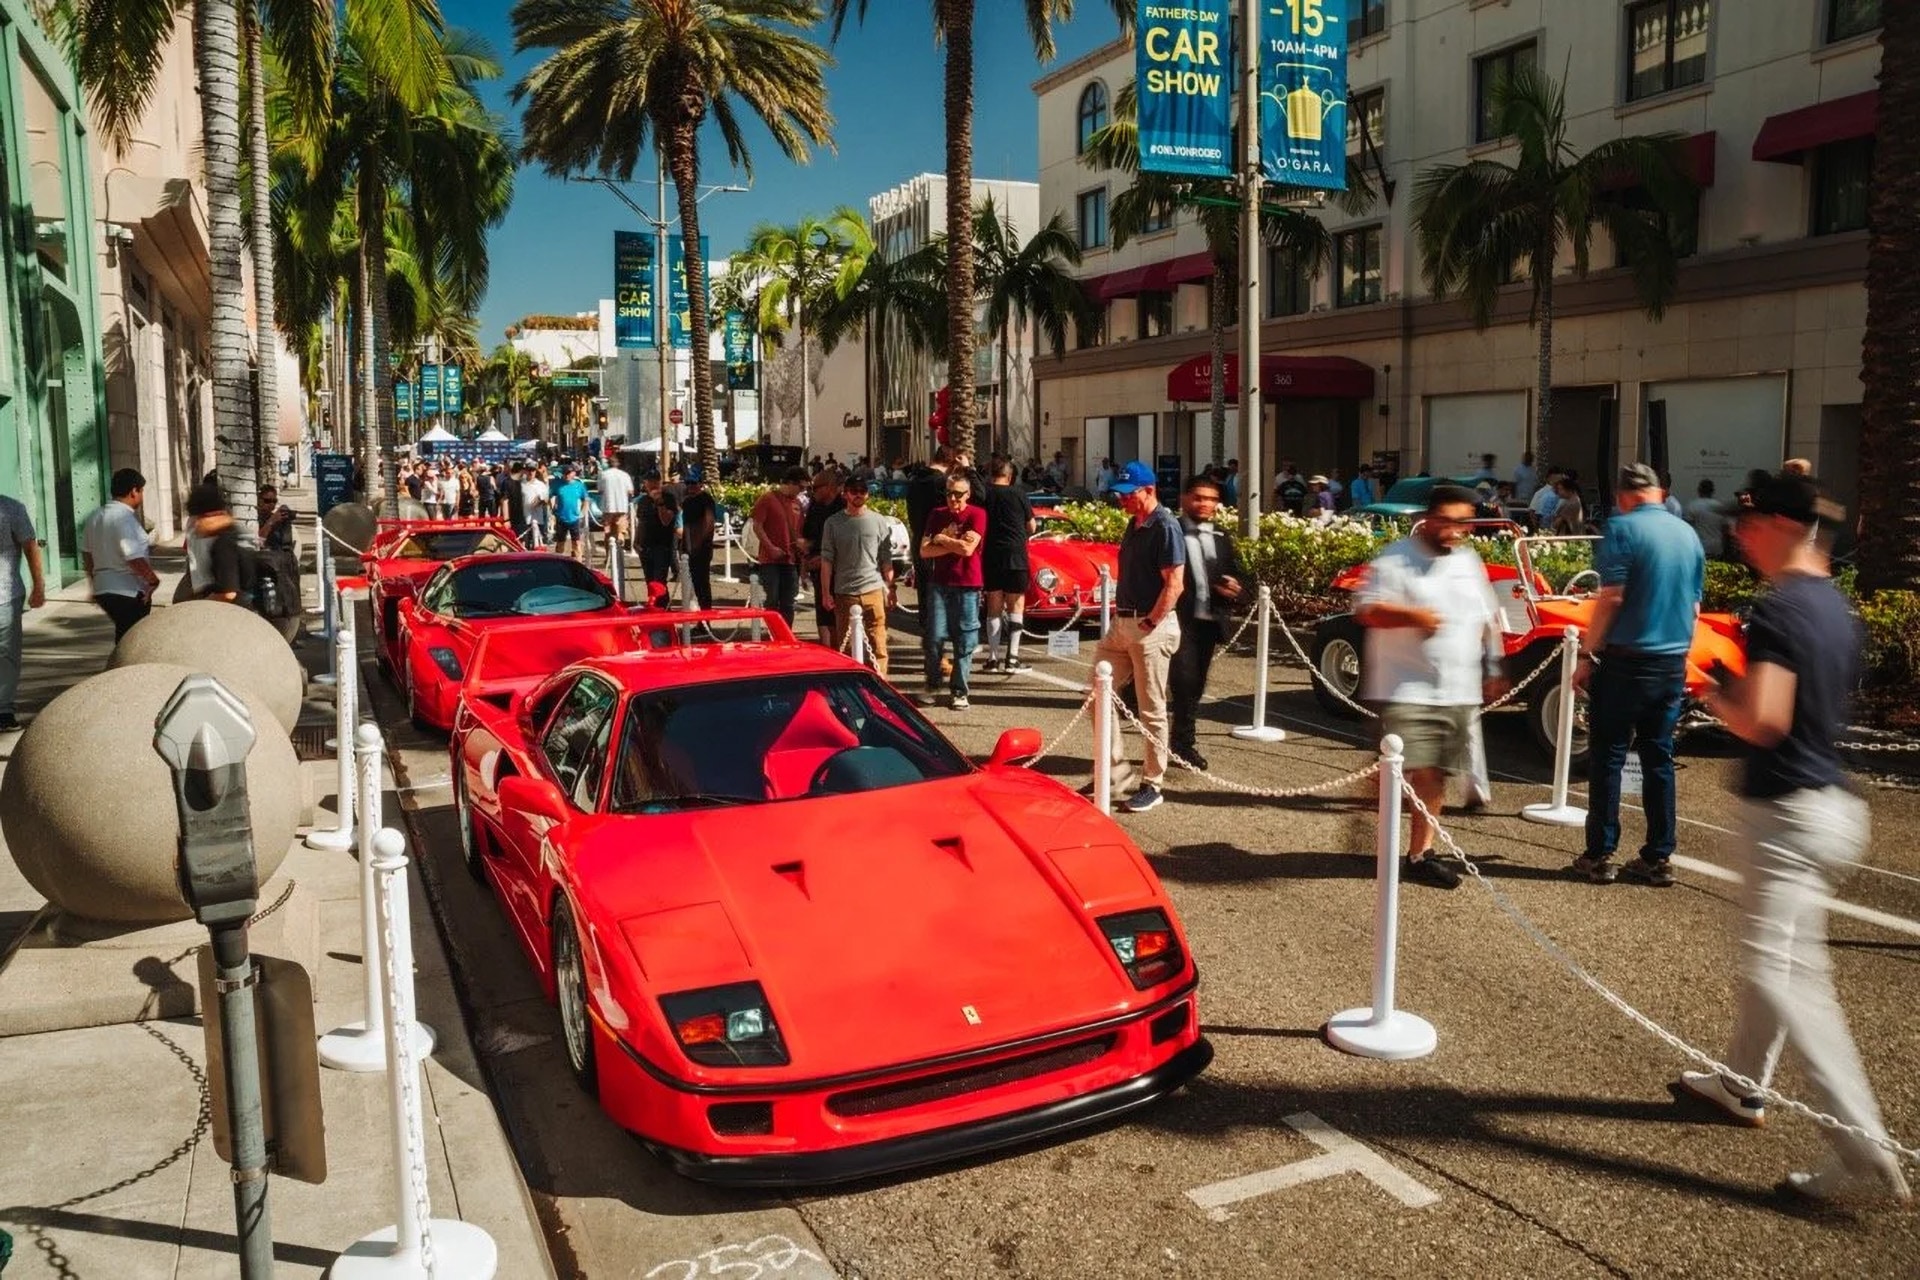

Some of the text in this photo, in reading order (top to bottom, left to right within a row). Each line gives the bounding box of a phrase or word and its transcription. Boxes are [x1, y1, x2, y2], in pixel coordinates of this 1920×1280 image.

[1145, 6, 1219, 23] FATHER'S DAY
[1145, 26, 1220, 66] CAR
[1146, 70, 1220, 97] SHOW
[1150, 144, 1221, 158] #ONLYONRODEO
[1277, 157, 1332, 174] O'GARA
[619, 290, 651, 305] CAR
[619, 306, 651, 318] SHOW
[1194, 363, 1230, 377] LUE
[1273, 373, 1293, 385] 360
